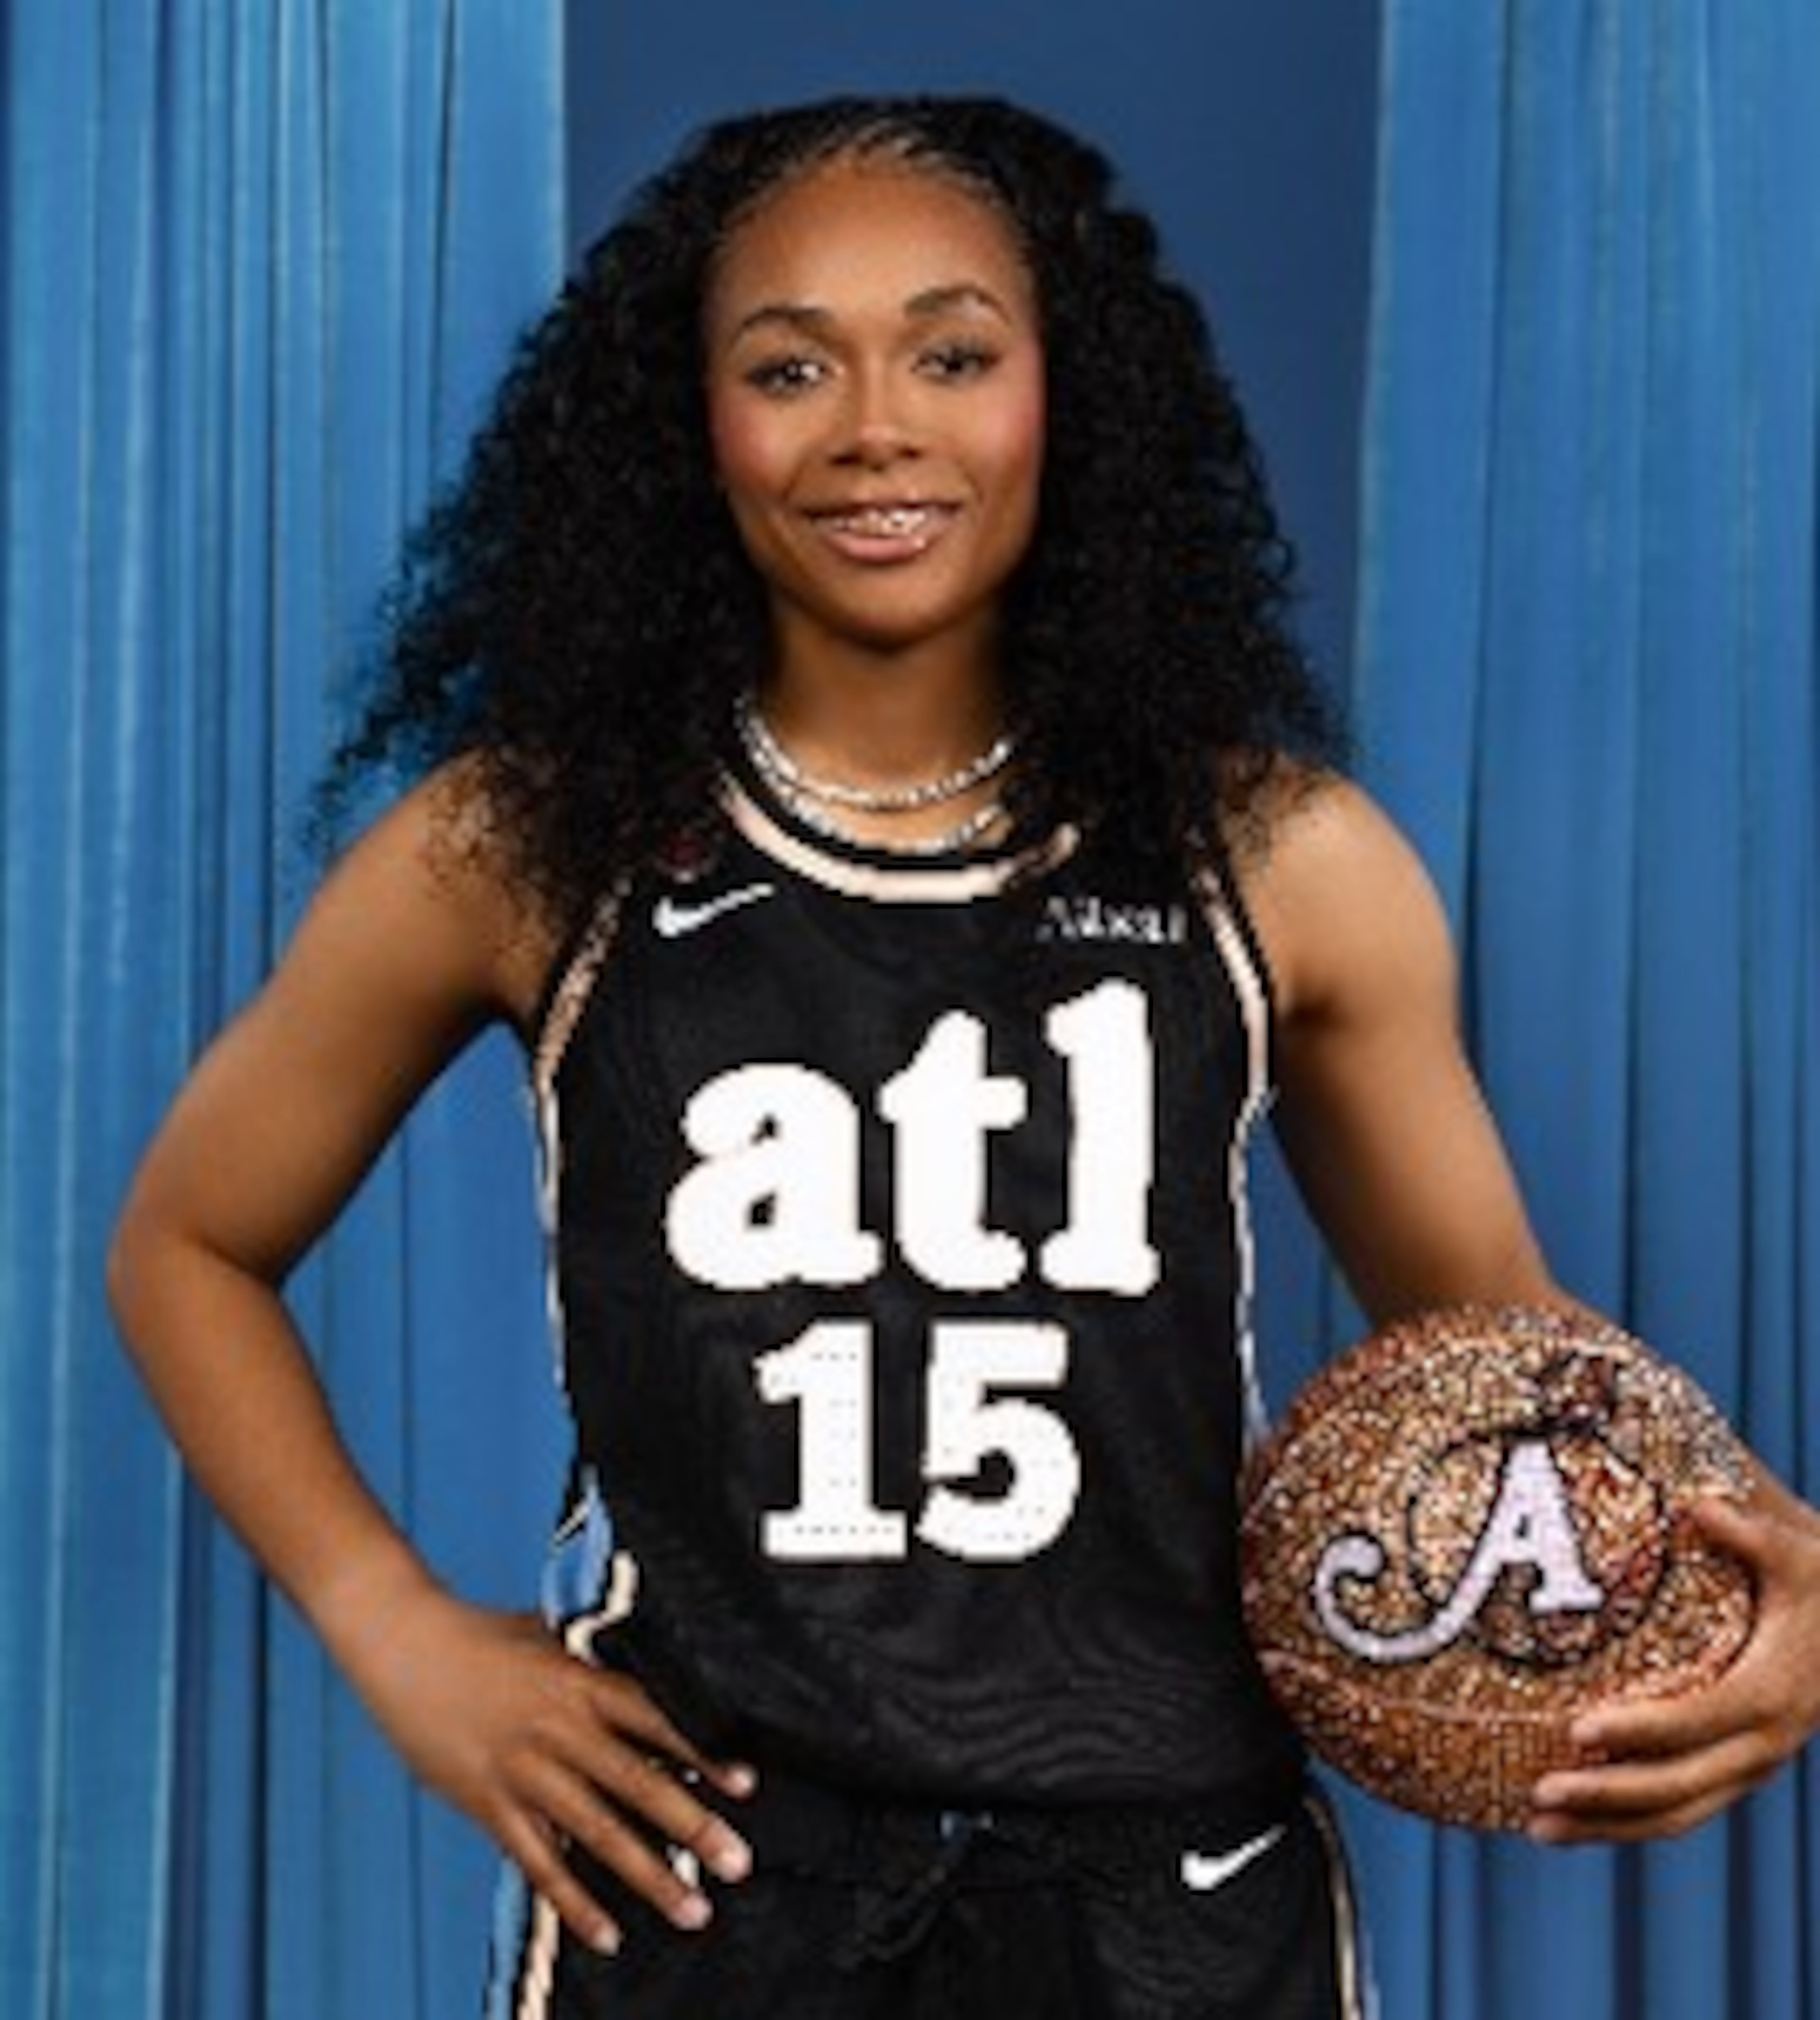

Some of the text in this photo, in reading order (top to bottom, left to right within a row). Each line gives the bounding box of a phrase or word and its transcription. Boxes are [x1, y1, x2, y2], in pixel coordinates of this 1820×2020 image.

[665, 978, 1161, 1295] atl
[755, 1321, 1081, 1557] 15
[1315, 1442, 1604, 1659] A
